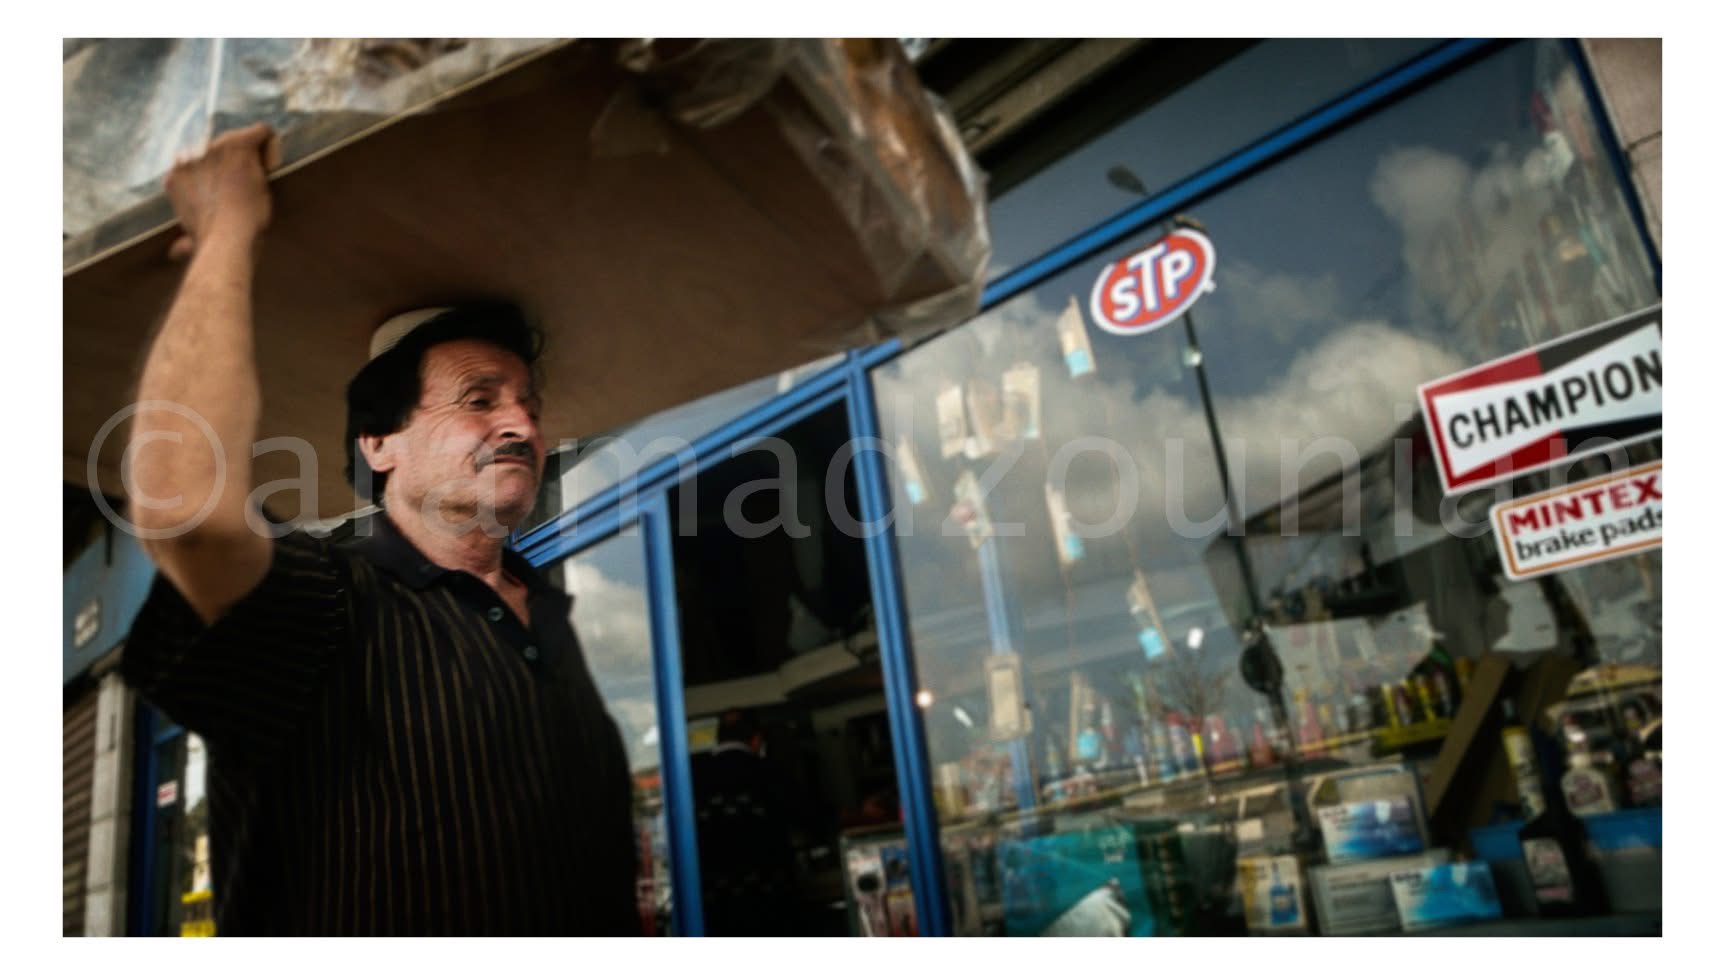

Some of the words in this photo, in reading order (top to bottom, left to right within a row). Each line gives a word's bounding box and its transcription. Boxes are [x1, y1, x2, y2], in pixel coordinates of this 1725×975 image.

[1110, 241, 1195, 321] STP
[1449, 350, 1662, 450] CHAMPION
[1508, 475, 1662, 536] MINTEX
[1515, 528, 1597, 562] brake
